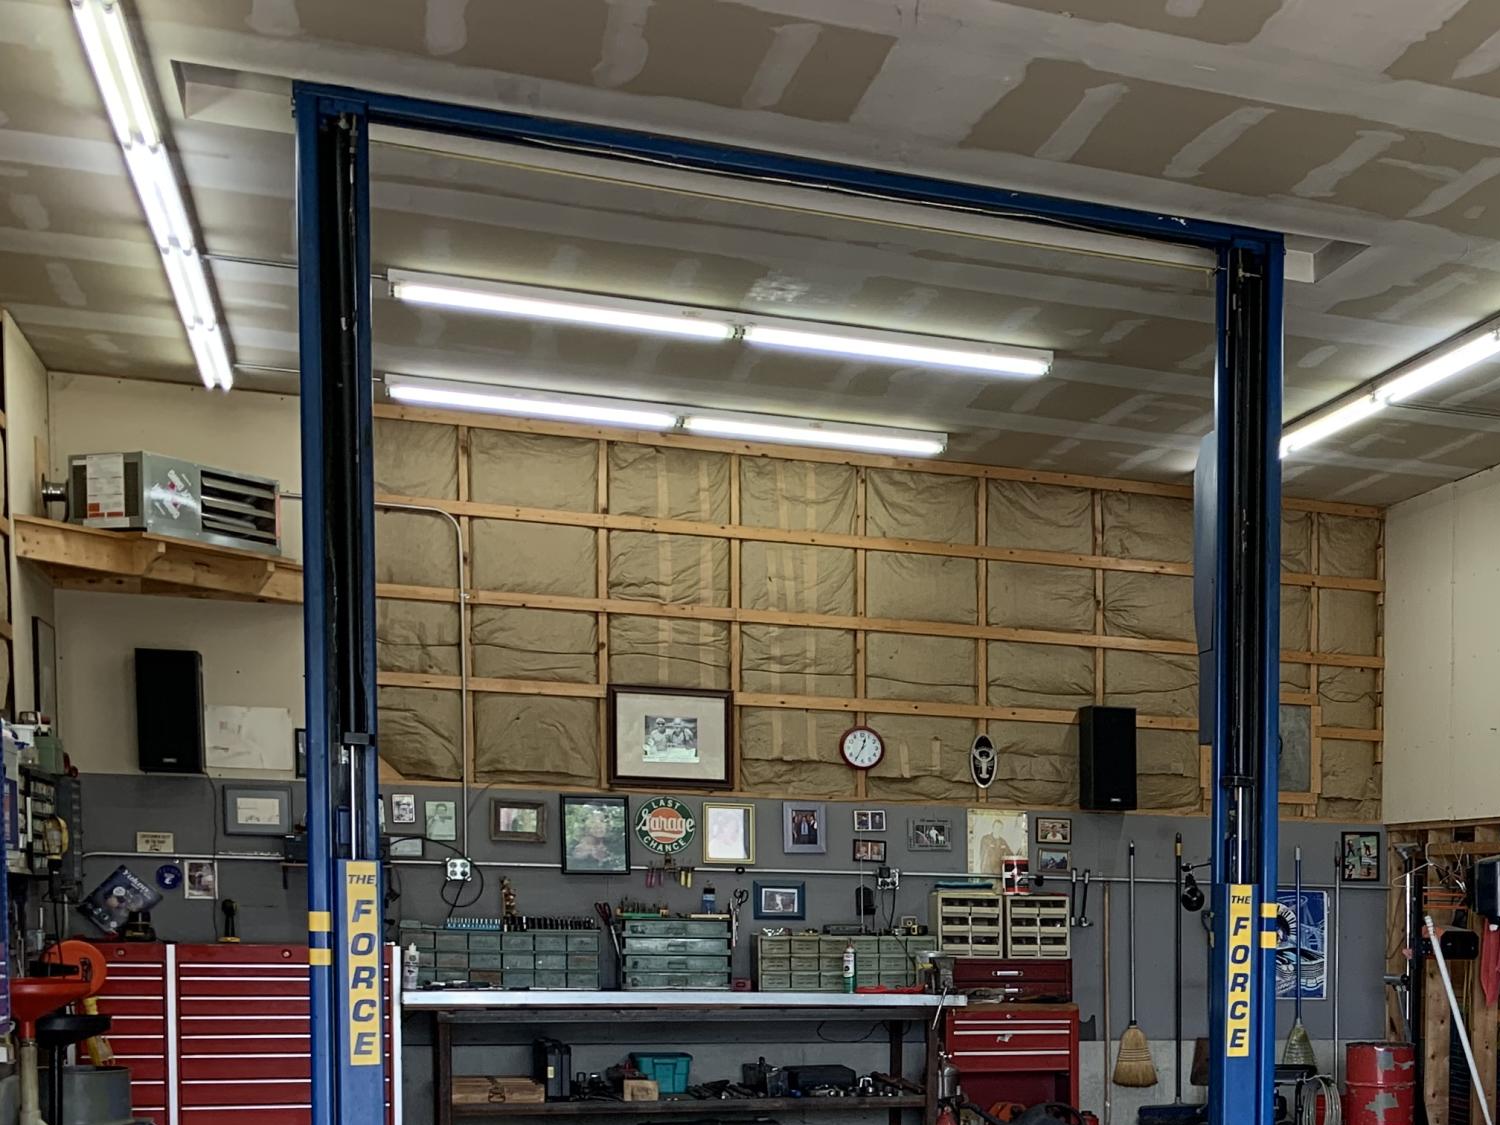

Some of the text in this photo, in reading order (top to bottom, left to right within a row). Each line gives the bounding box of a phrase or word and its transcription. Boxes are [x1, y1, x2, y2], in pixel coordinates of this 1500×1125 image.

[651, 799, 681, 809] LAST
[635, 808, 696, 839] Garage
[643, 836, 687, 852] CHANCE
[348, 874, 376, 885] THE
[1231, 896, 1251, 904] THE
[350, 899, 377, 1056] FORCE
[1229, 917, 1250, 1049] FORCE
